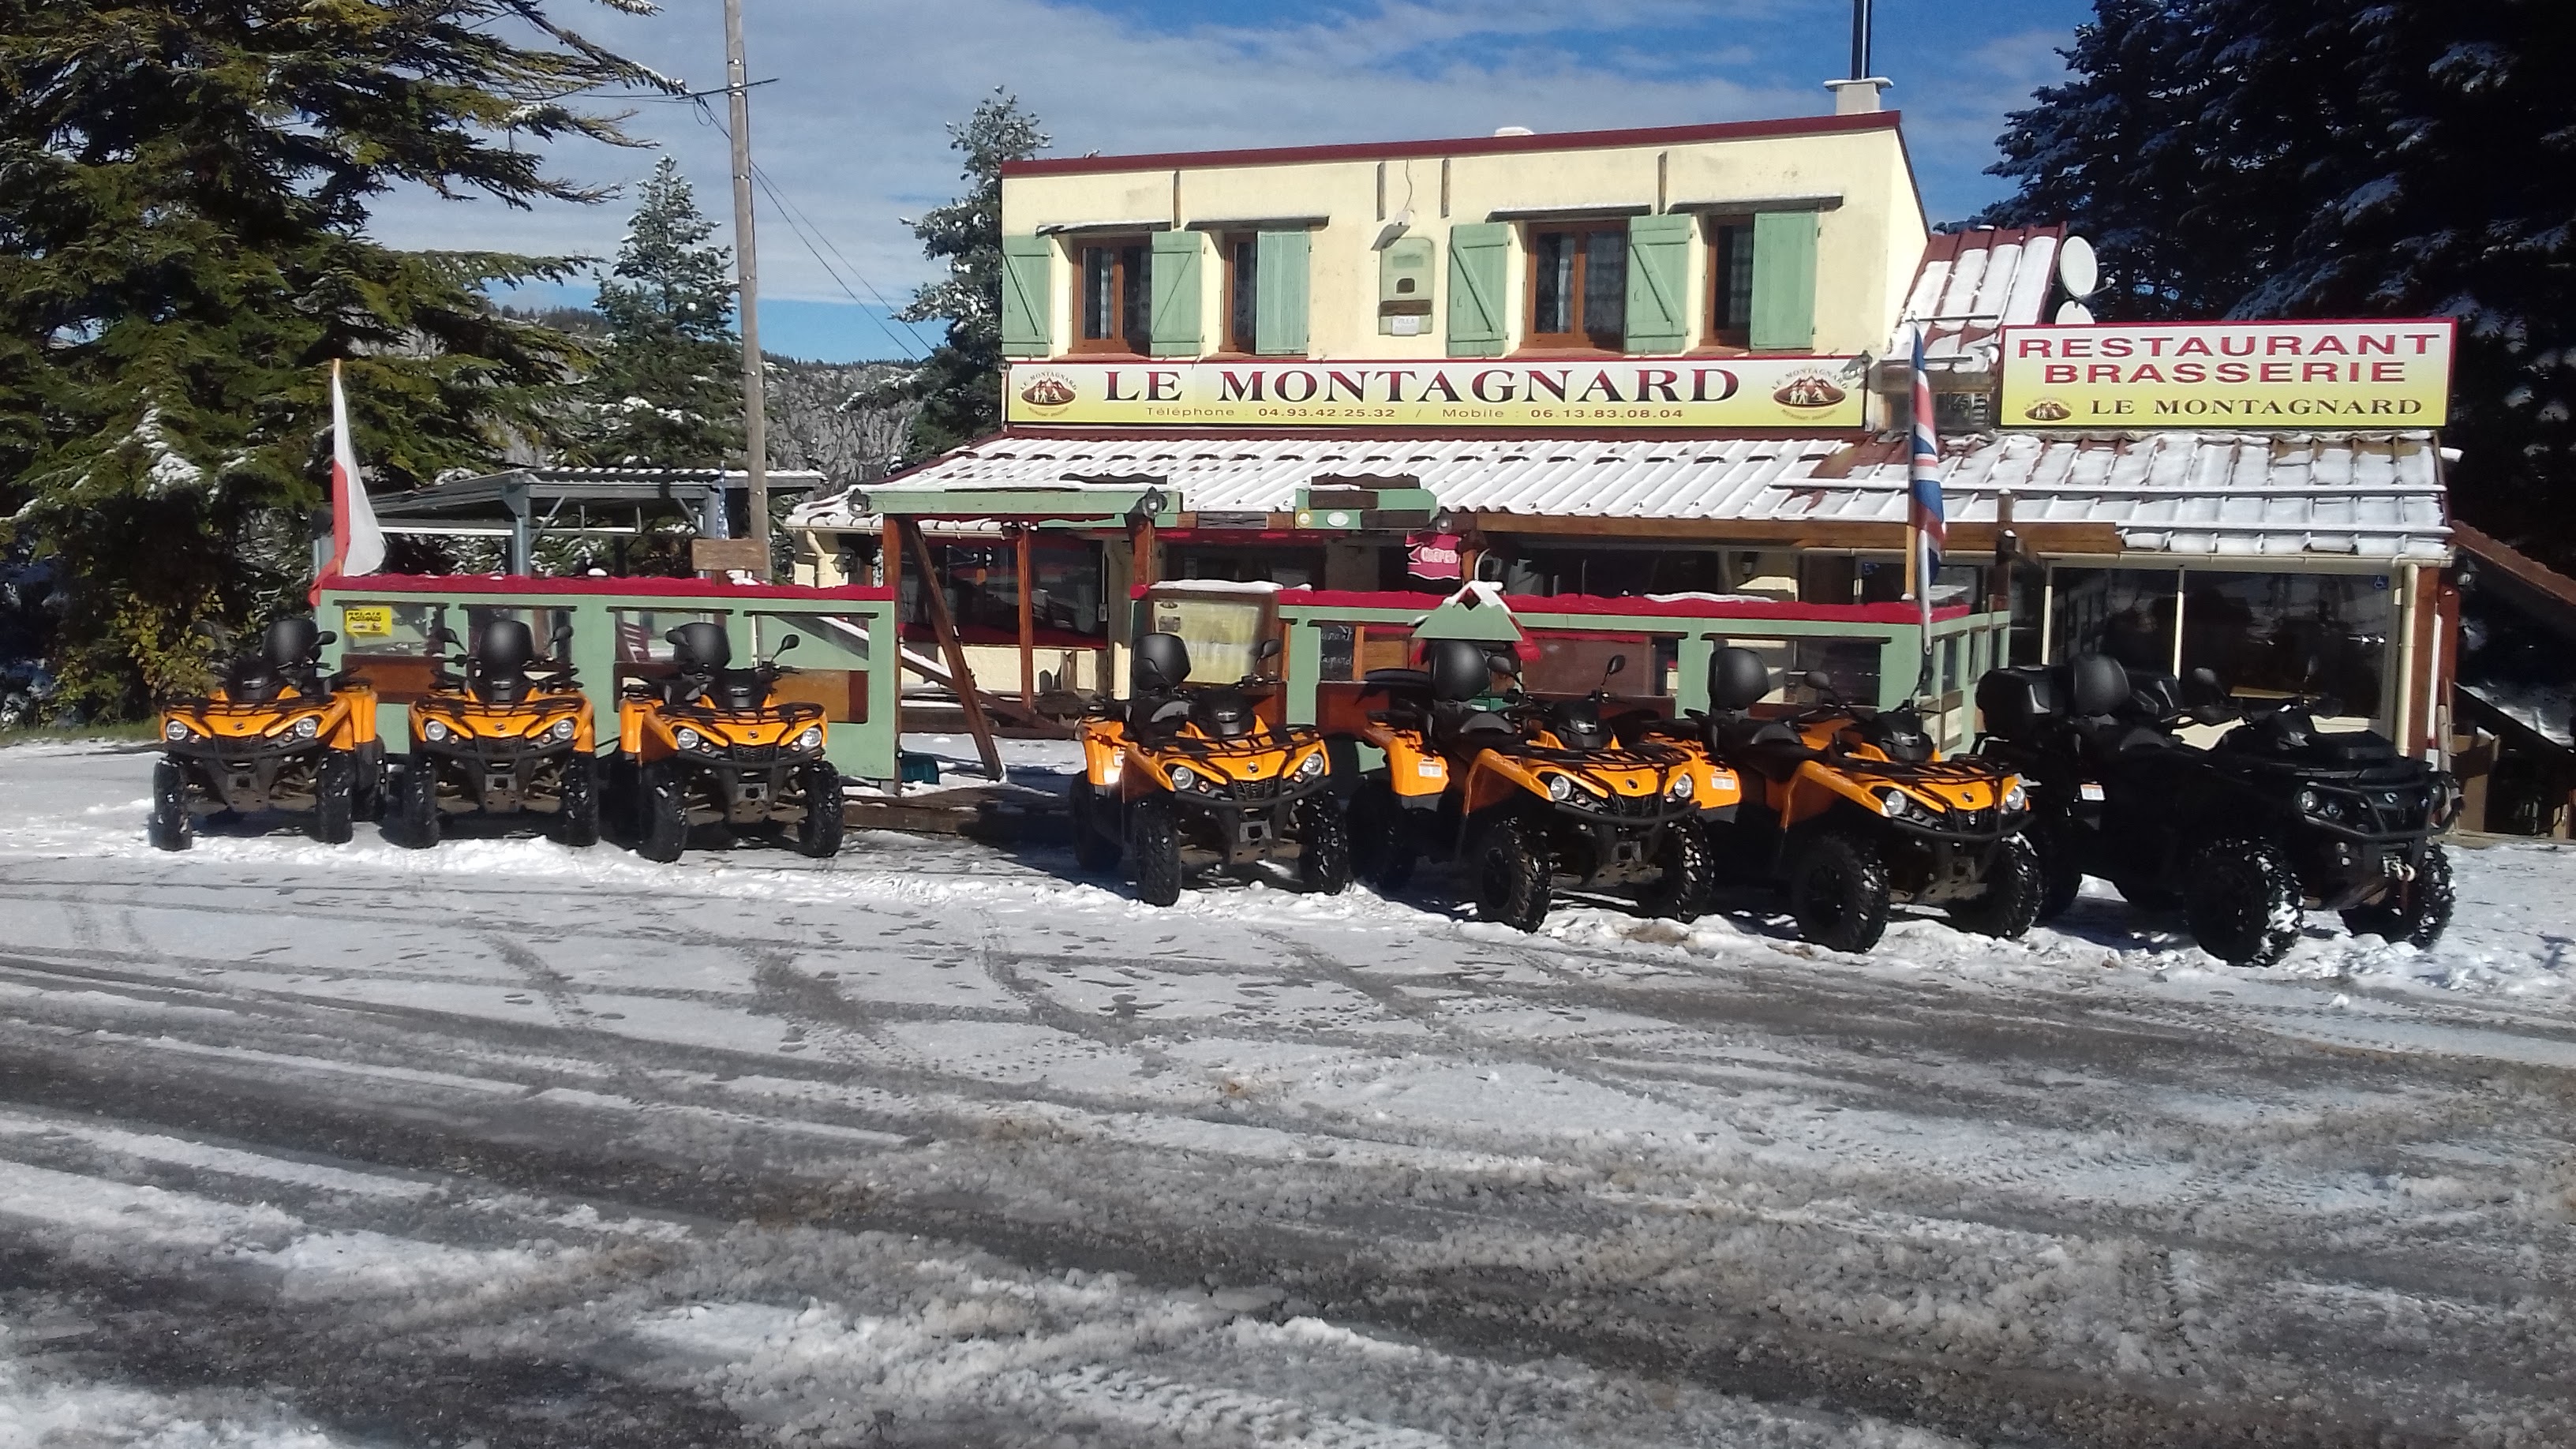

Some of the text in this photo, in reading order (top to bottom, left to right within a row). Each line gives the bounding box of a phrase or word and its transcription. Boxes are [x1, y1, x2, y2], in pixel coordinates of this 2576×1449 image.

[2018, 334, 2440, 358] RESTAURANT
[1029, 371, 1077, 391] MONTAGNARD
[1785, 368, 1848, 389] MONTAGNARD
[2044, 361, 2406, 384] BRASSERIE
[1103, 369, 1739, 403] LE MONTAGNARD
[1146, 406, 1235, 417] Téléphone
[1257, 408, 1396, 417] 04.93.42.25.32
[1442, 408, 1504, 418] Mobile
[1530, 409, 1683, 419] 06.13.83.08.04
[2091, 399, 2135, 415] LE
[2153, 398, 2422, 415] MONTAGNARD
